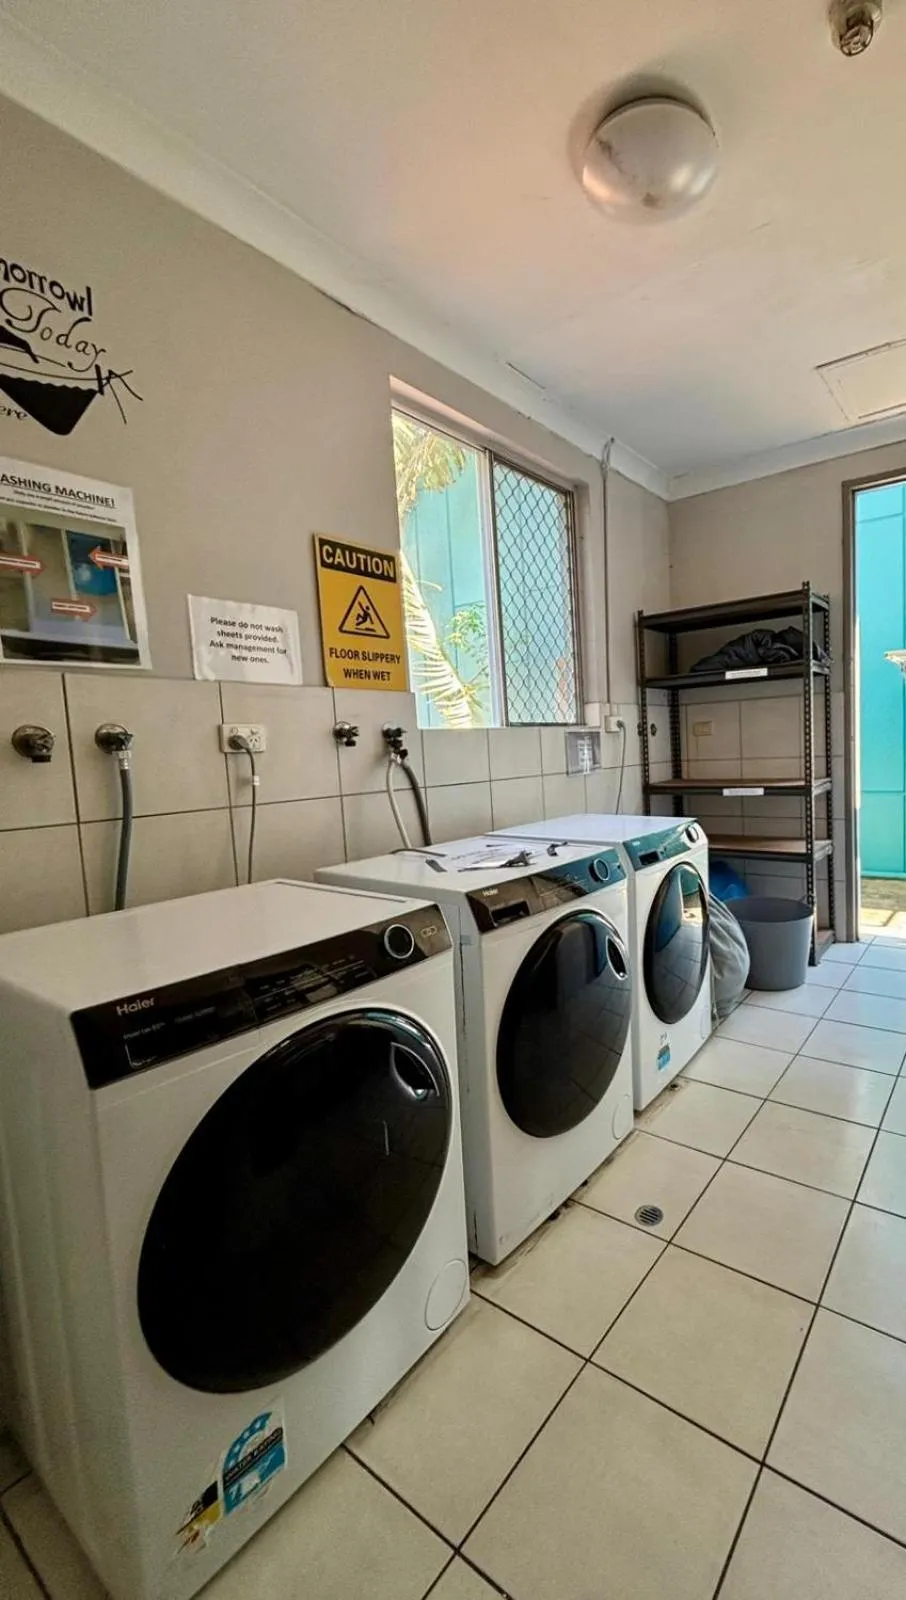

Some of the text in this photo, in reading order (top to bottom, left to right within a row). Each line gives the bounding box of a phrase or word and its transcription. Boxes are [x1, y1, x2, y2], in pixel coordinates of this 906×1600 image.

[0, 288, 107, 372] Today
[322, 544, 395, 578] CAUTION
[210, 616, 284, 633] Please do not wash
[217, 629, 243, 639] sheets
[209, 640, 224, 648] Ask
[226, 642, 275, 653] management
[329, 646, 401, 665] FLOOR SLIPPERY
[343, 667, 391, 681] WHEN WET
[115, 996, 156, 1017] Haier
